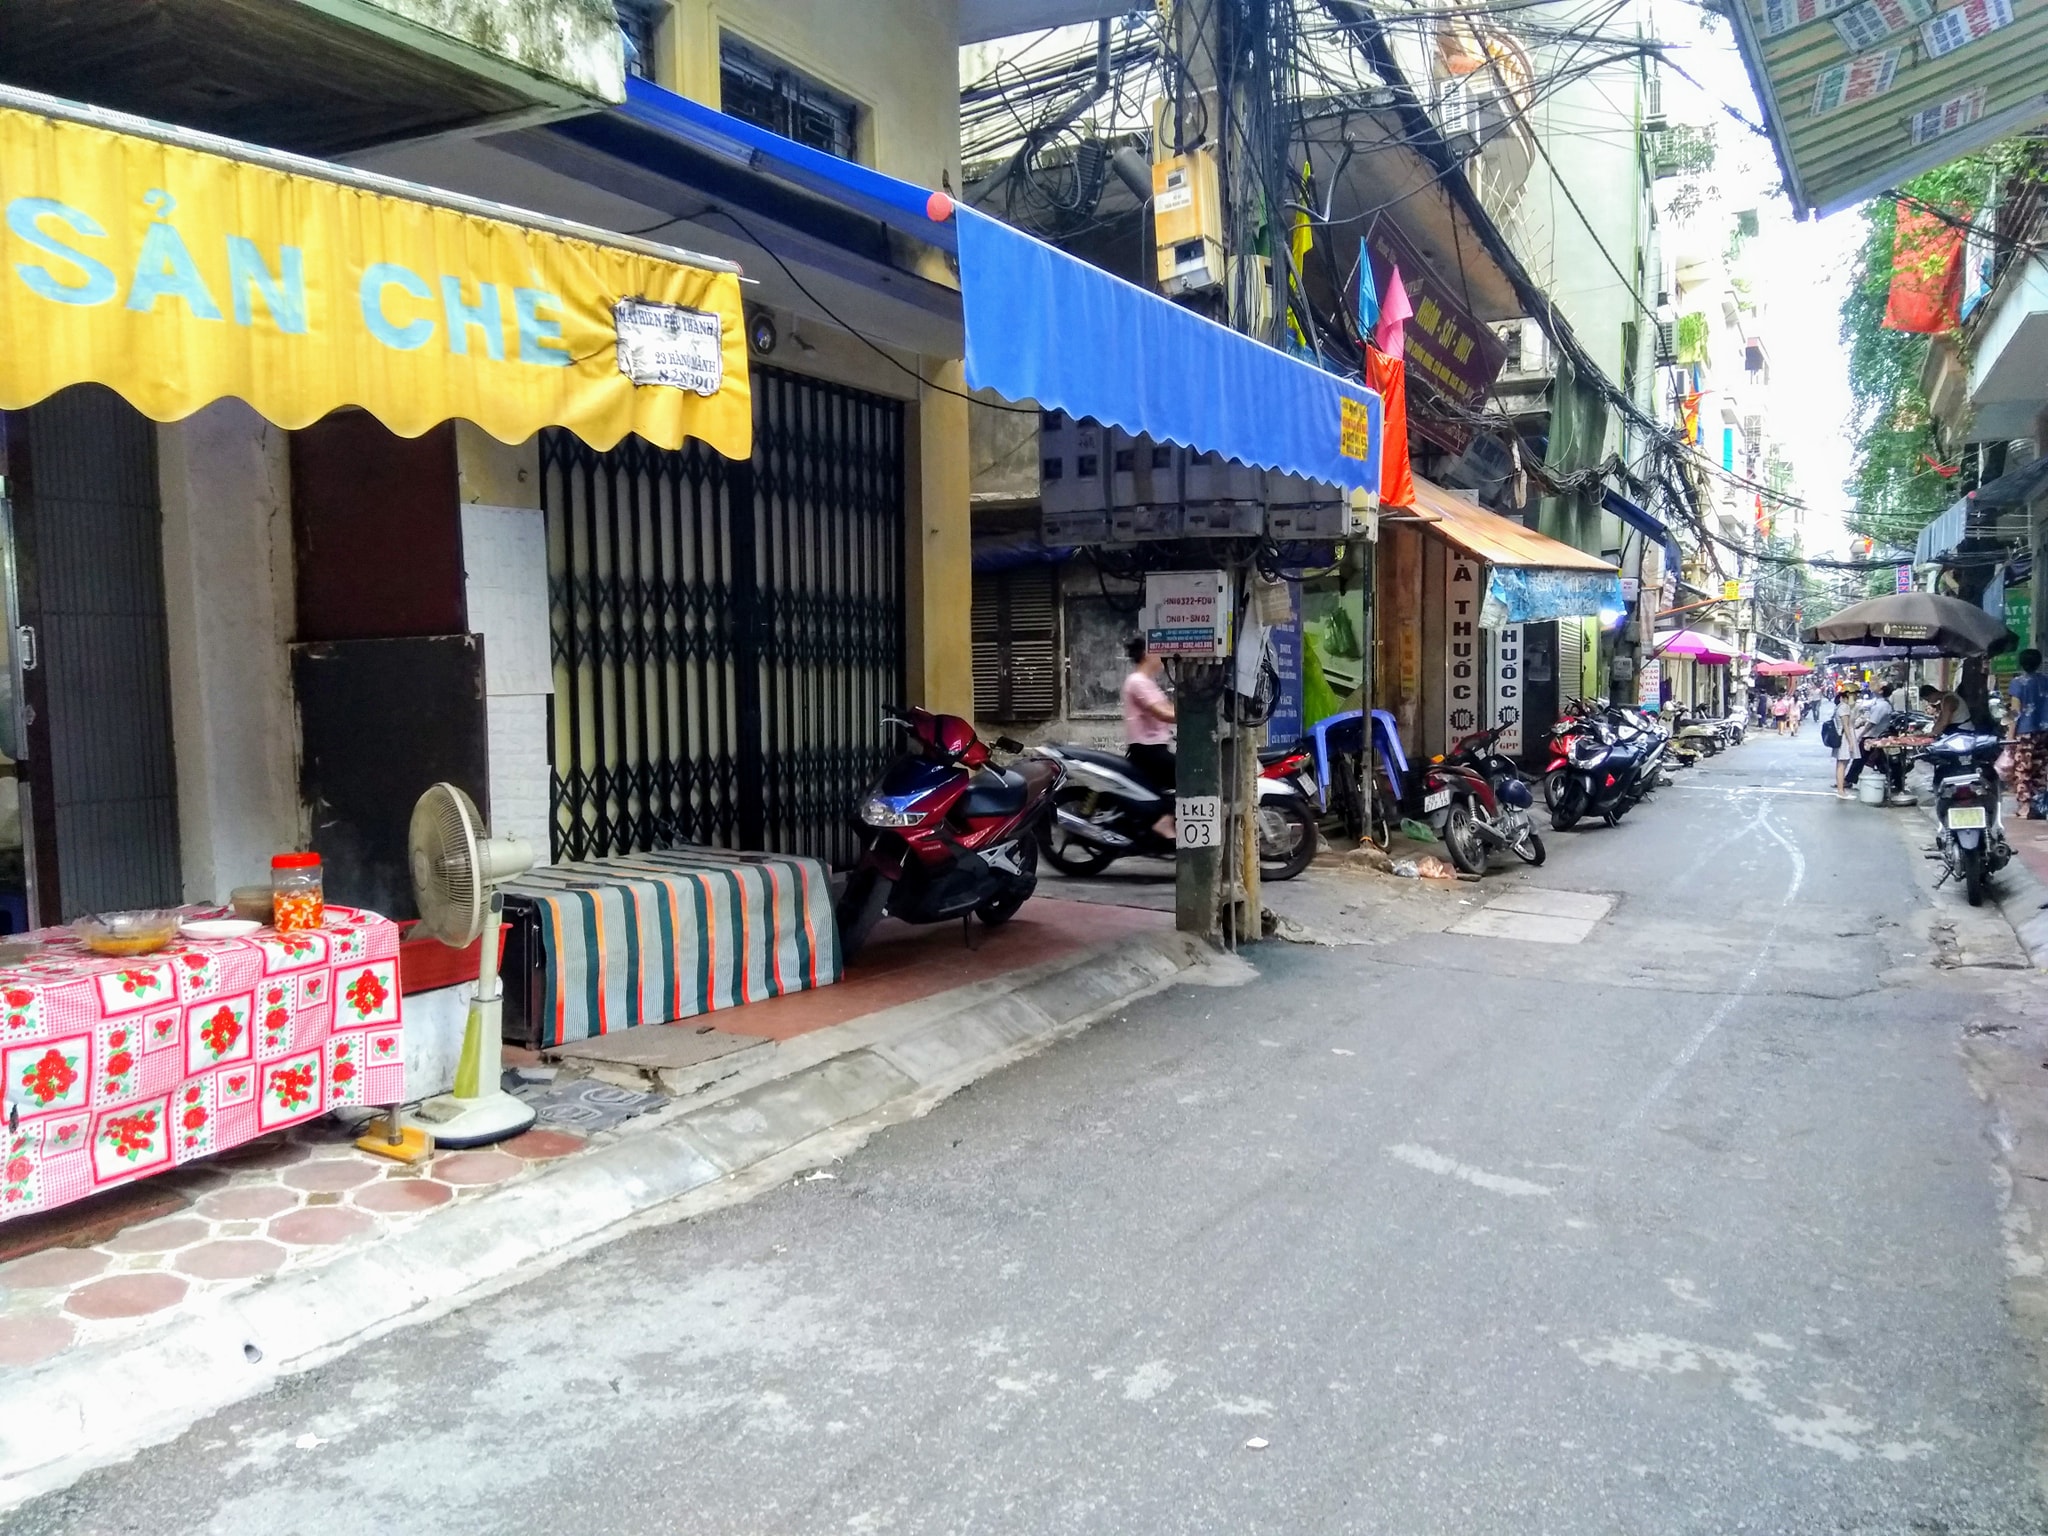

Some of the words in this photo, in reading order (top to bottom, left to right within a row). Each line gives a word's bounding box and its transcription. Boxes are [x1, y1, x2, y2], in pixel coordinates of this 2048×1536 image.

[4, 187, 308, 335] SẢN
[655, 351, 667, 365] 23
[1453, 600, 1472, 700] THUỐC
[1501, 630, 1517, 698] HUỐC
[1455, 713, 1470, 727] 108
[1502, 709, 1516, 722] 108
[1182, 802, 1215, 818] LKL3
[1184, 823, 1211, 846] 03
